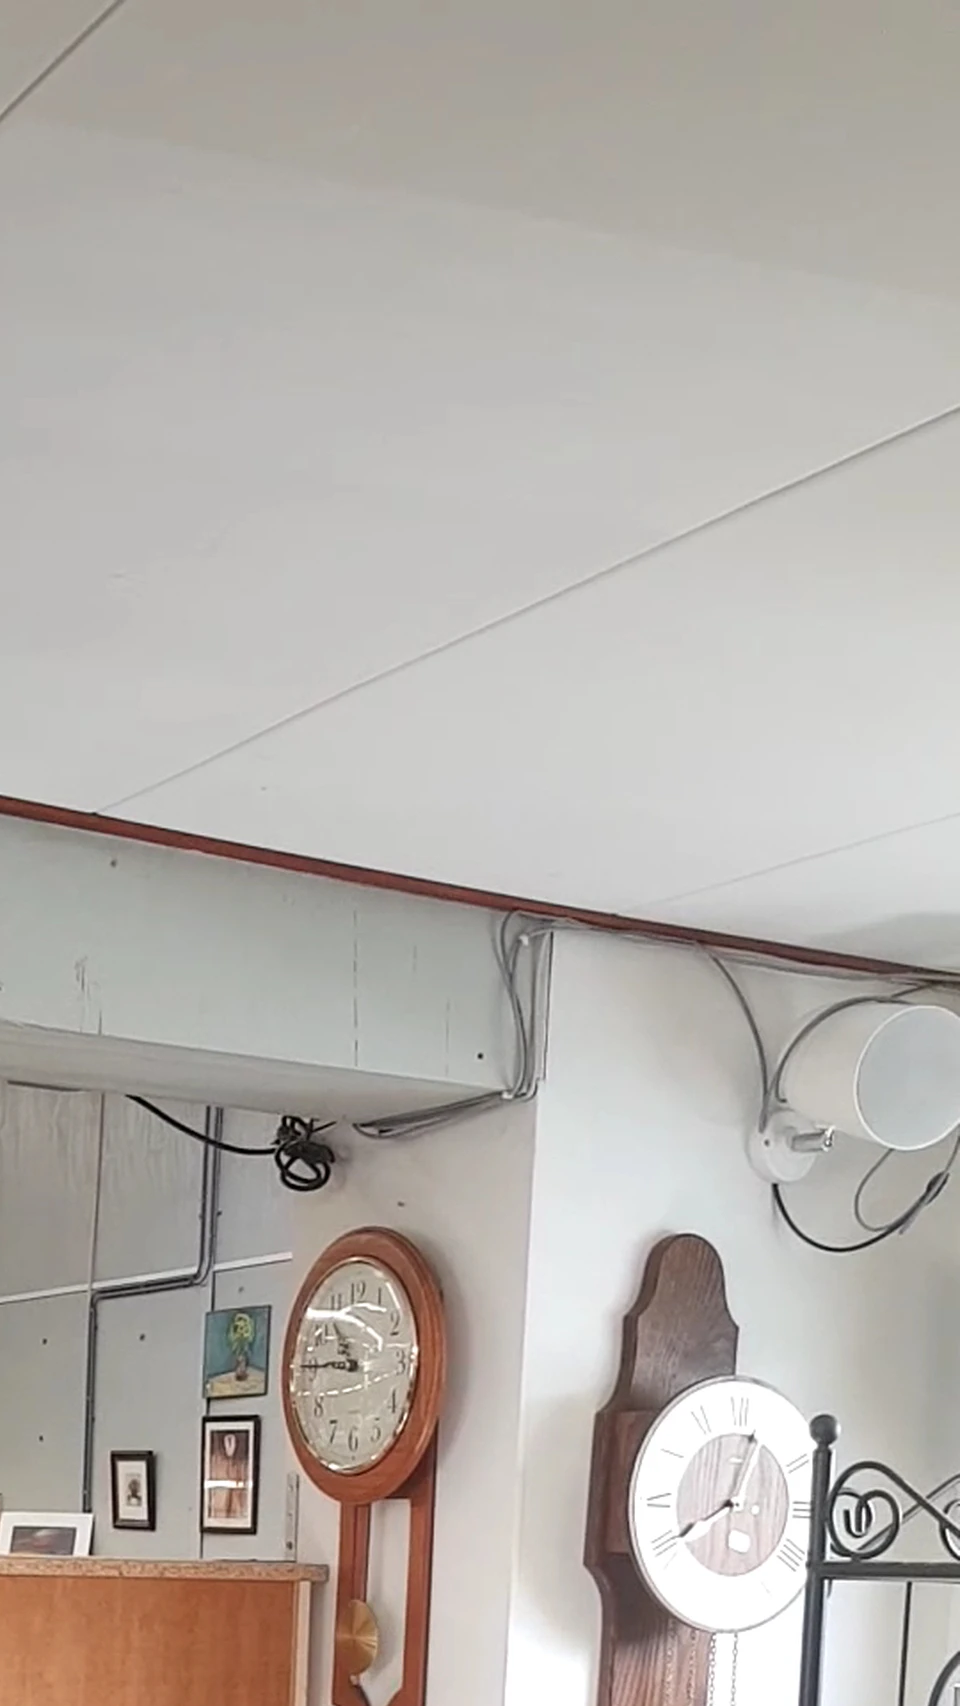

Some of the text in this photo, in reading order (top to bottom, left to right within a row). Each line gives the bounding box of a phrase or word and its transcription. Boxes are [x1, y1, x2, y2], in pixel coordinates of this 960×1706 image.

[314, 1395, 324, 1418] 8
[328, 1418, 339, 1445] 7
[347, 1425, 359, 1452] 6
